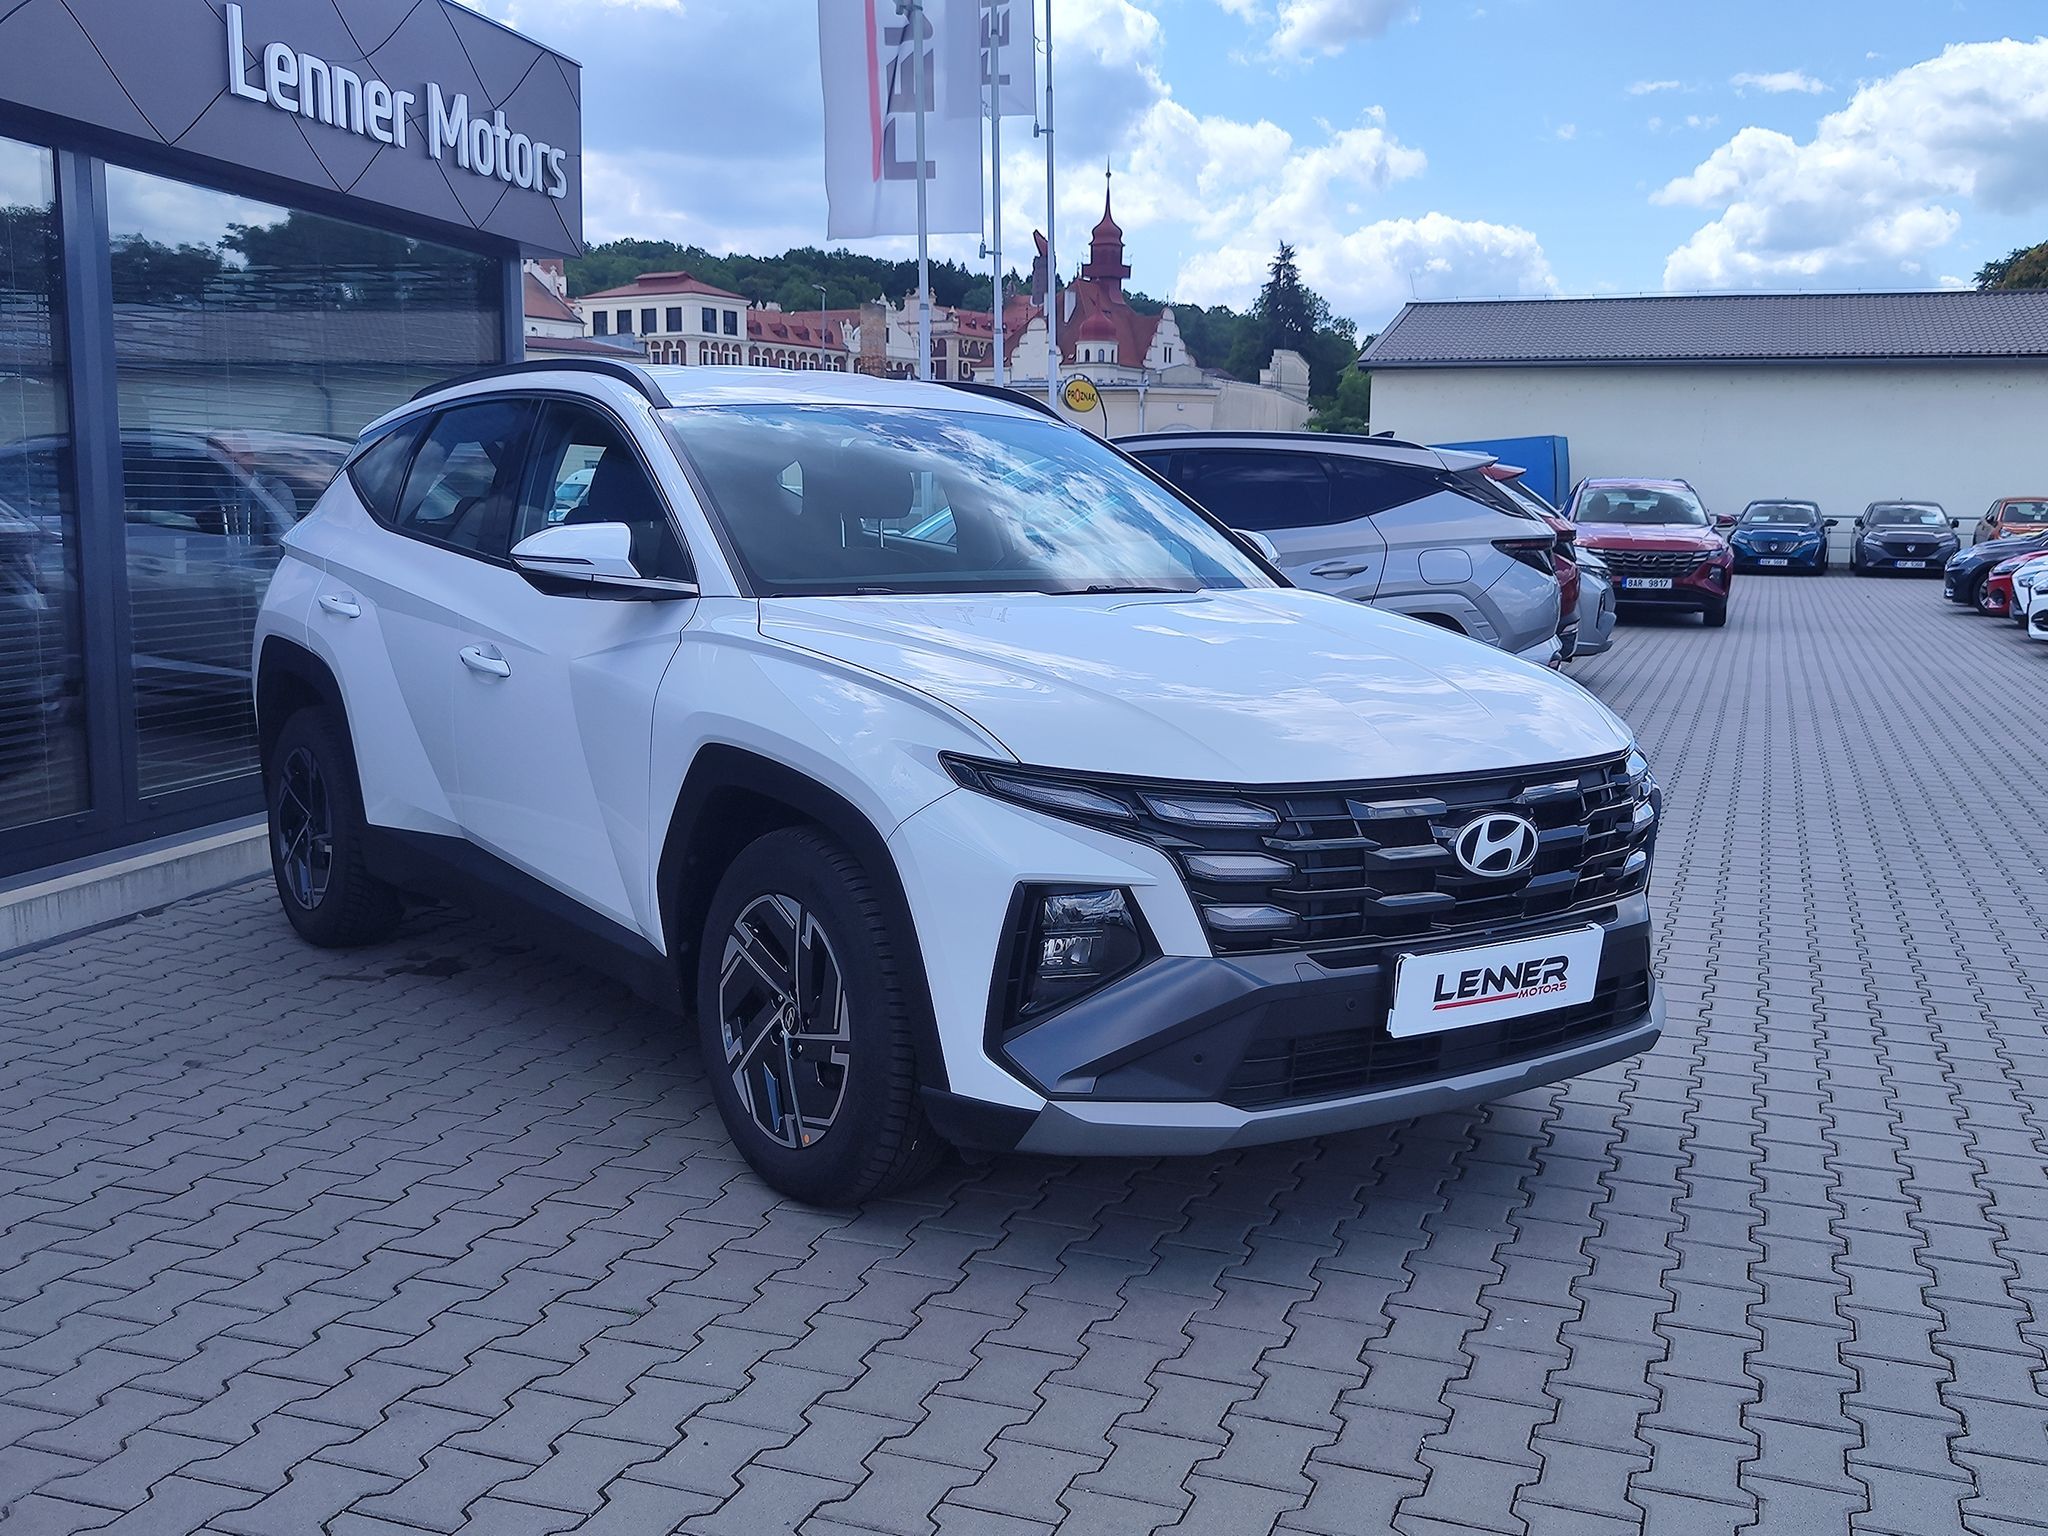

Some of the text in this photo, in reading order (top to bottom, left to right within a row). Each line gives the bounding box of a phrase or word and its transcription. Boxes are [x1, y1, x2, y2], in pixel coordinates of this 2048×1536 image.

[227, 3, 568, 200] Lenner Motors
[1067, 388, 1096, 403] PROZNAK
[1628, 579, 1669, 588] 8AR 9817
[1434, 956, 1569, 1002] LENNER
[1519, 982, 1567, 998] MOTORS
